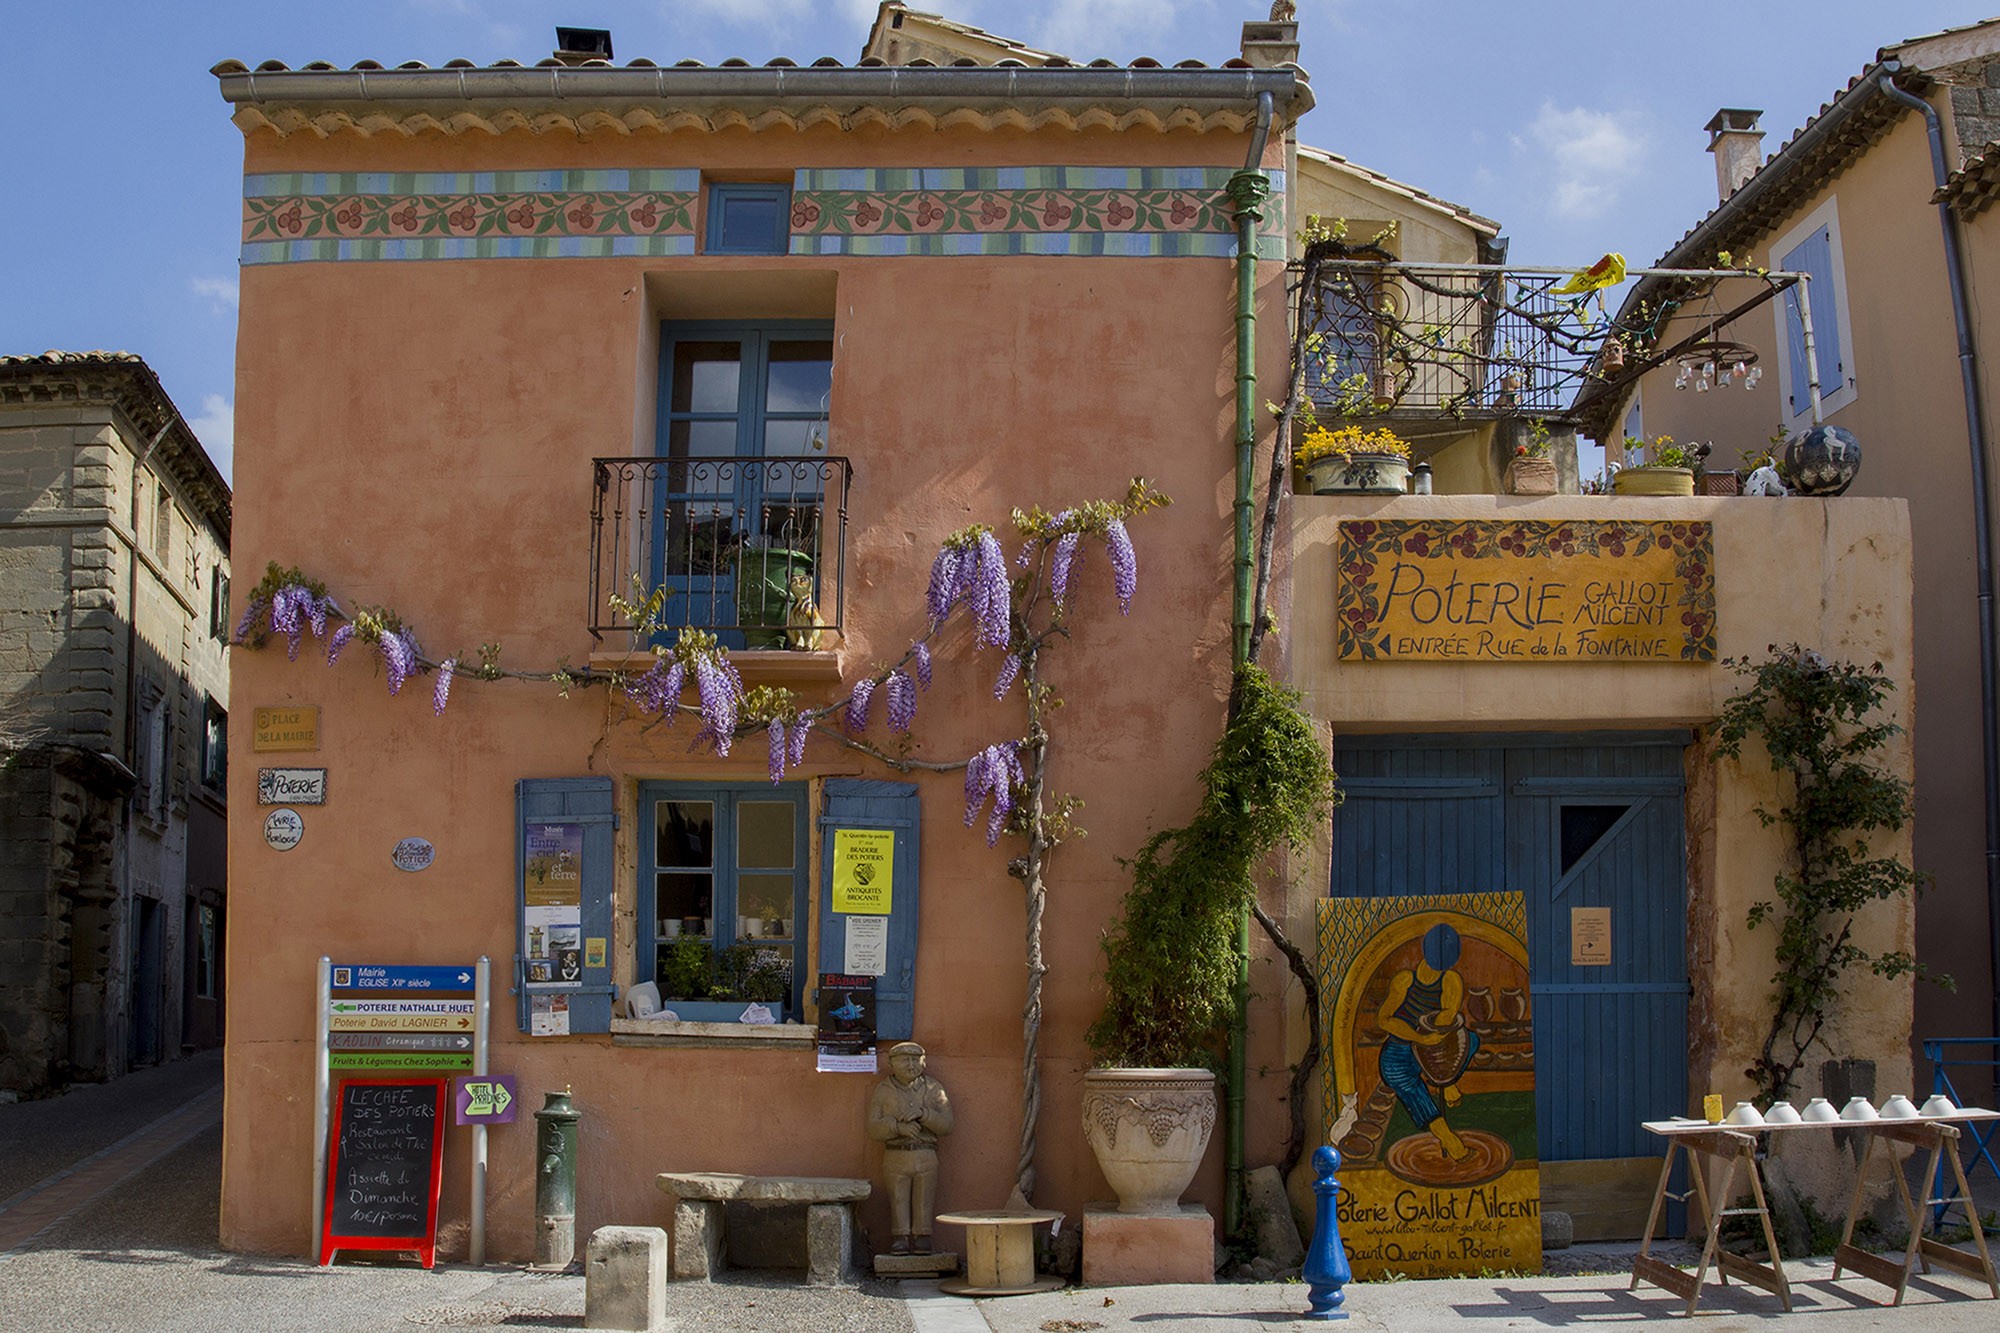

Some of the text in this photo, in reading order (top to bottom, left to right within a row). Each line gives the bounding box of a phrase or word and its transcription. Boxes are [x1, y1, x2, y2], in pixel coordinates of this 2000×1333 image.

[1584, 580, 1674, 605] GALLOT
[1397, 632, 1469, 656] ENTRÉE
[1530, 636, 1550, 656] de
[1553, 632, 1567, 656] la
[272, 713, 301, 725] PLACE
[257, 730, 314, 742] DE LA MAIRIE
[530, 836, 561, 849] Entre
[536, 847, 556, 858] ciel
[551, 862, 562, 872] et
[550, 870, 577, 880] terre
[846, 894, 880, 902] BROCANTE
[357, 967, 386, 978] Mairie
[358, 978, 389, 987] EGLISE
[357, 1003, 474, 1014] POTERIE NATHALIE HUET
[333, 1017, 448, 1028] Poterie David LAGNIER
[330, 1034, 382, 1047] KAOLIN
[332, 1056, 455, 1068] Fruits & Légumes Chez Sophie
[350, 1088, 372, 1105] LE
[353, 1103, 436, 1119] DES POTIERS
[350, 1187, 419, 1206] Dimanche
[1341, 1236, 1512, 1263] Saint Quentin la Poterie
